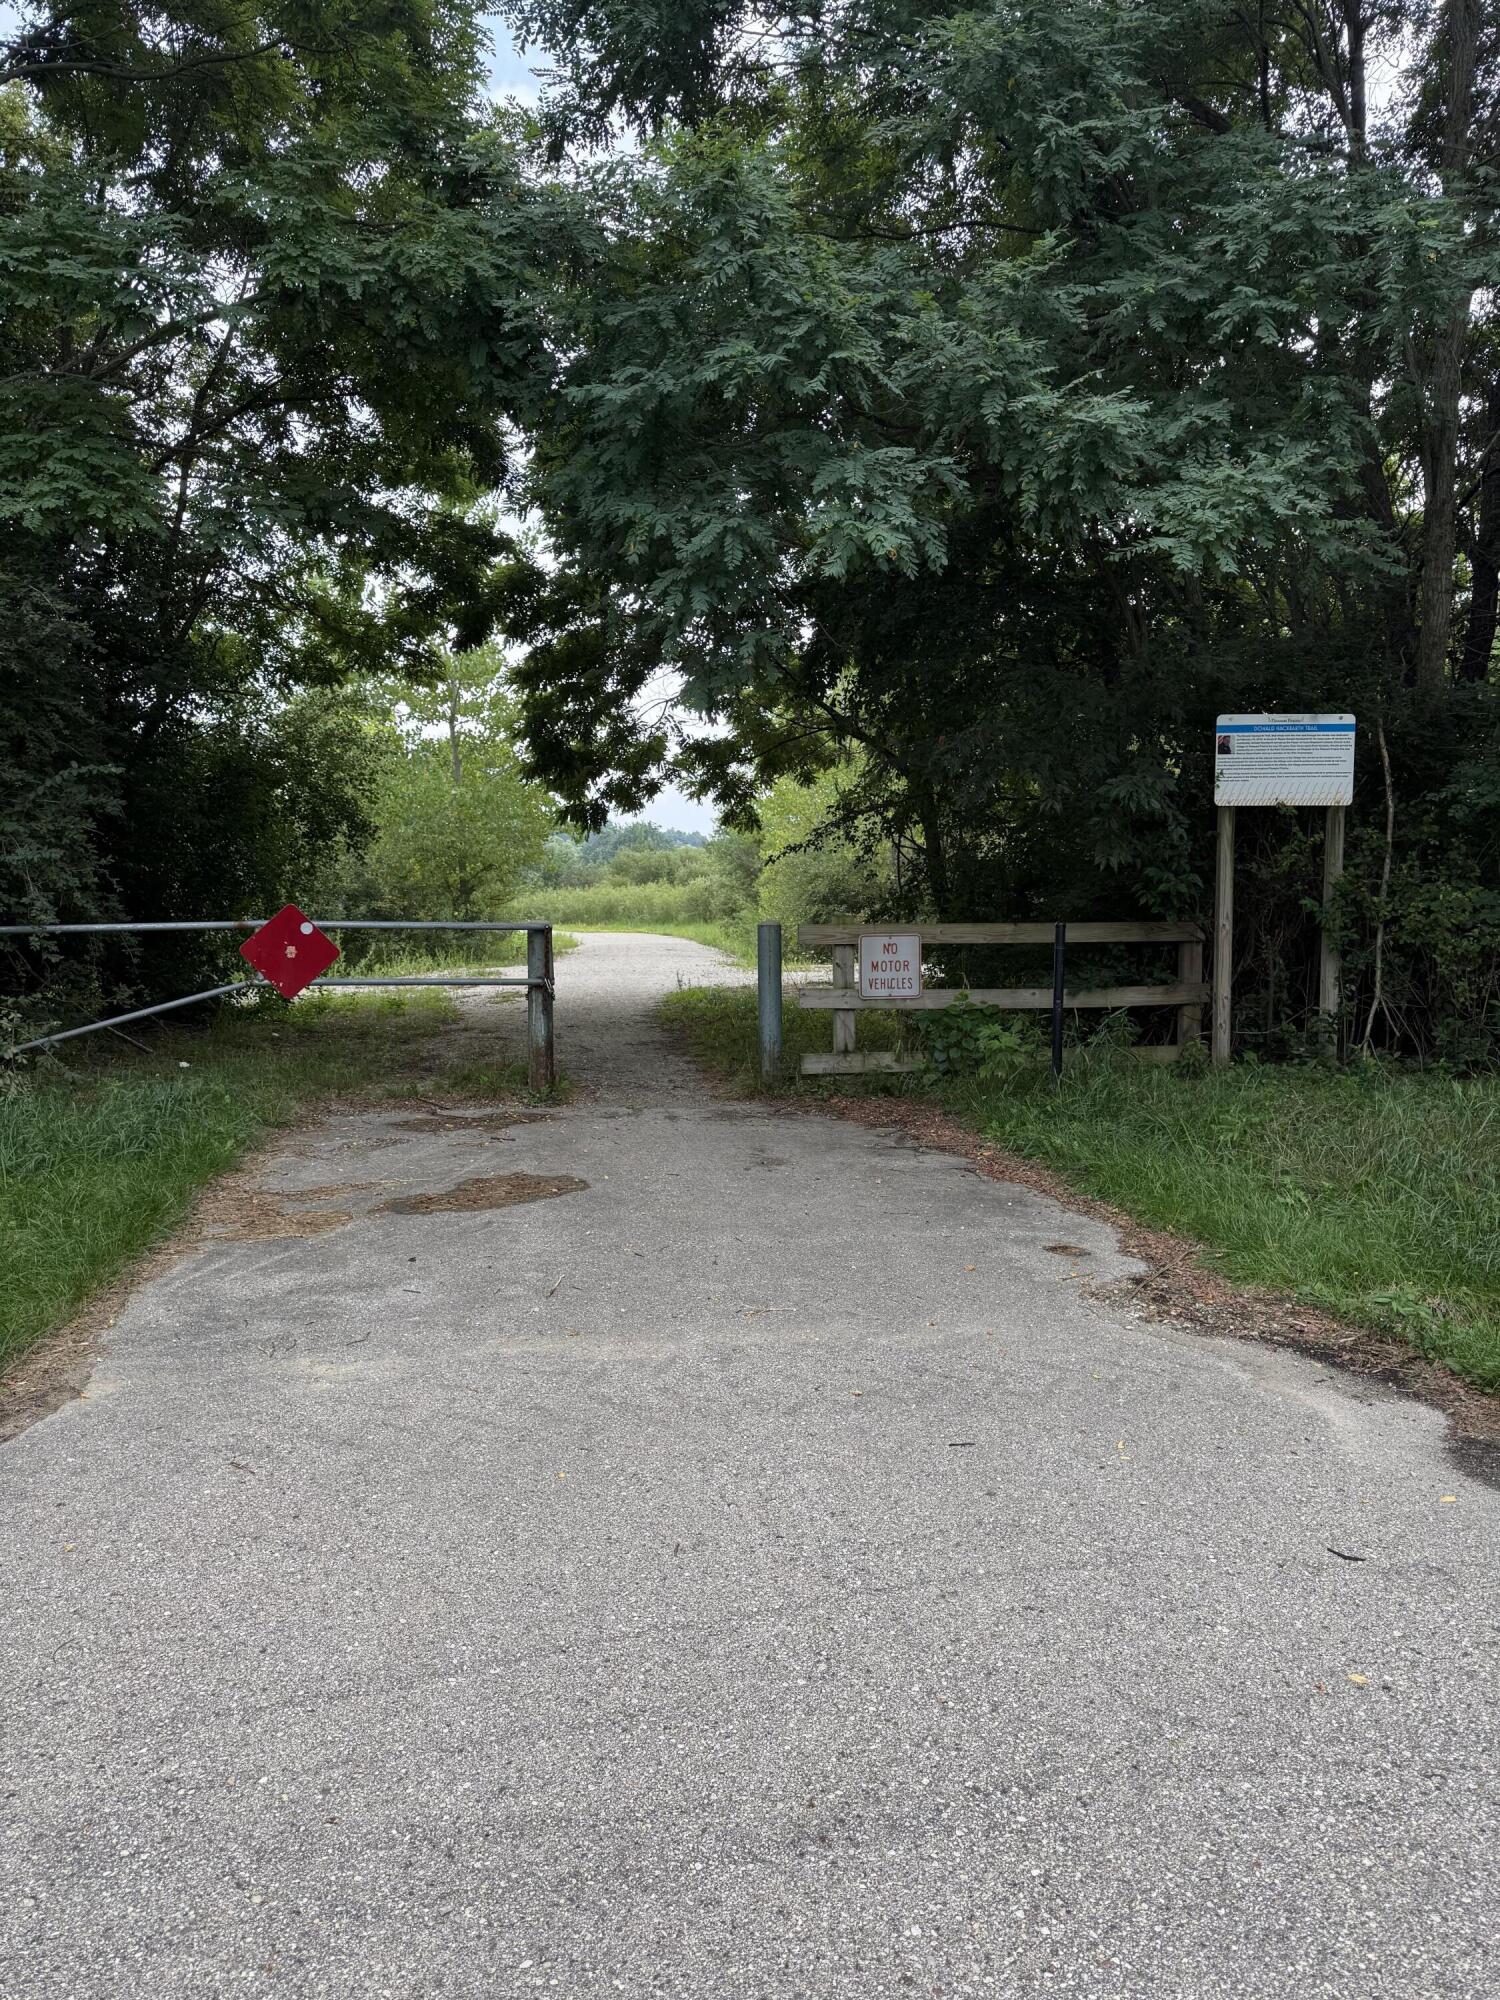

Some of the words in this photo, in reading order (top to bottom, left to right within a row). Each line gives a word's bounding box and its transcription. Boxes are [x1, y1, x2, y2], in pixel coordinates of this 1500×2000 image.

[883, 943, 898, 954] NO
[871, 960, 910, 972] MOTOR
[868, 977, 913, 990] VEHICLES
